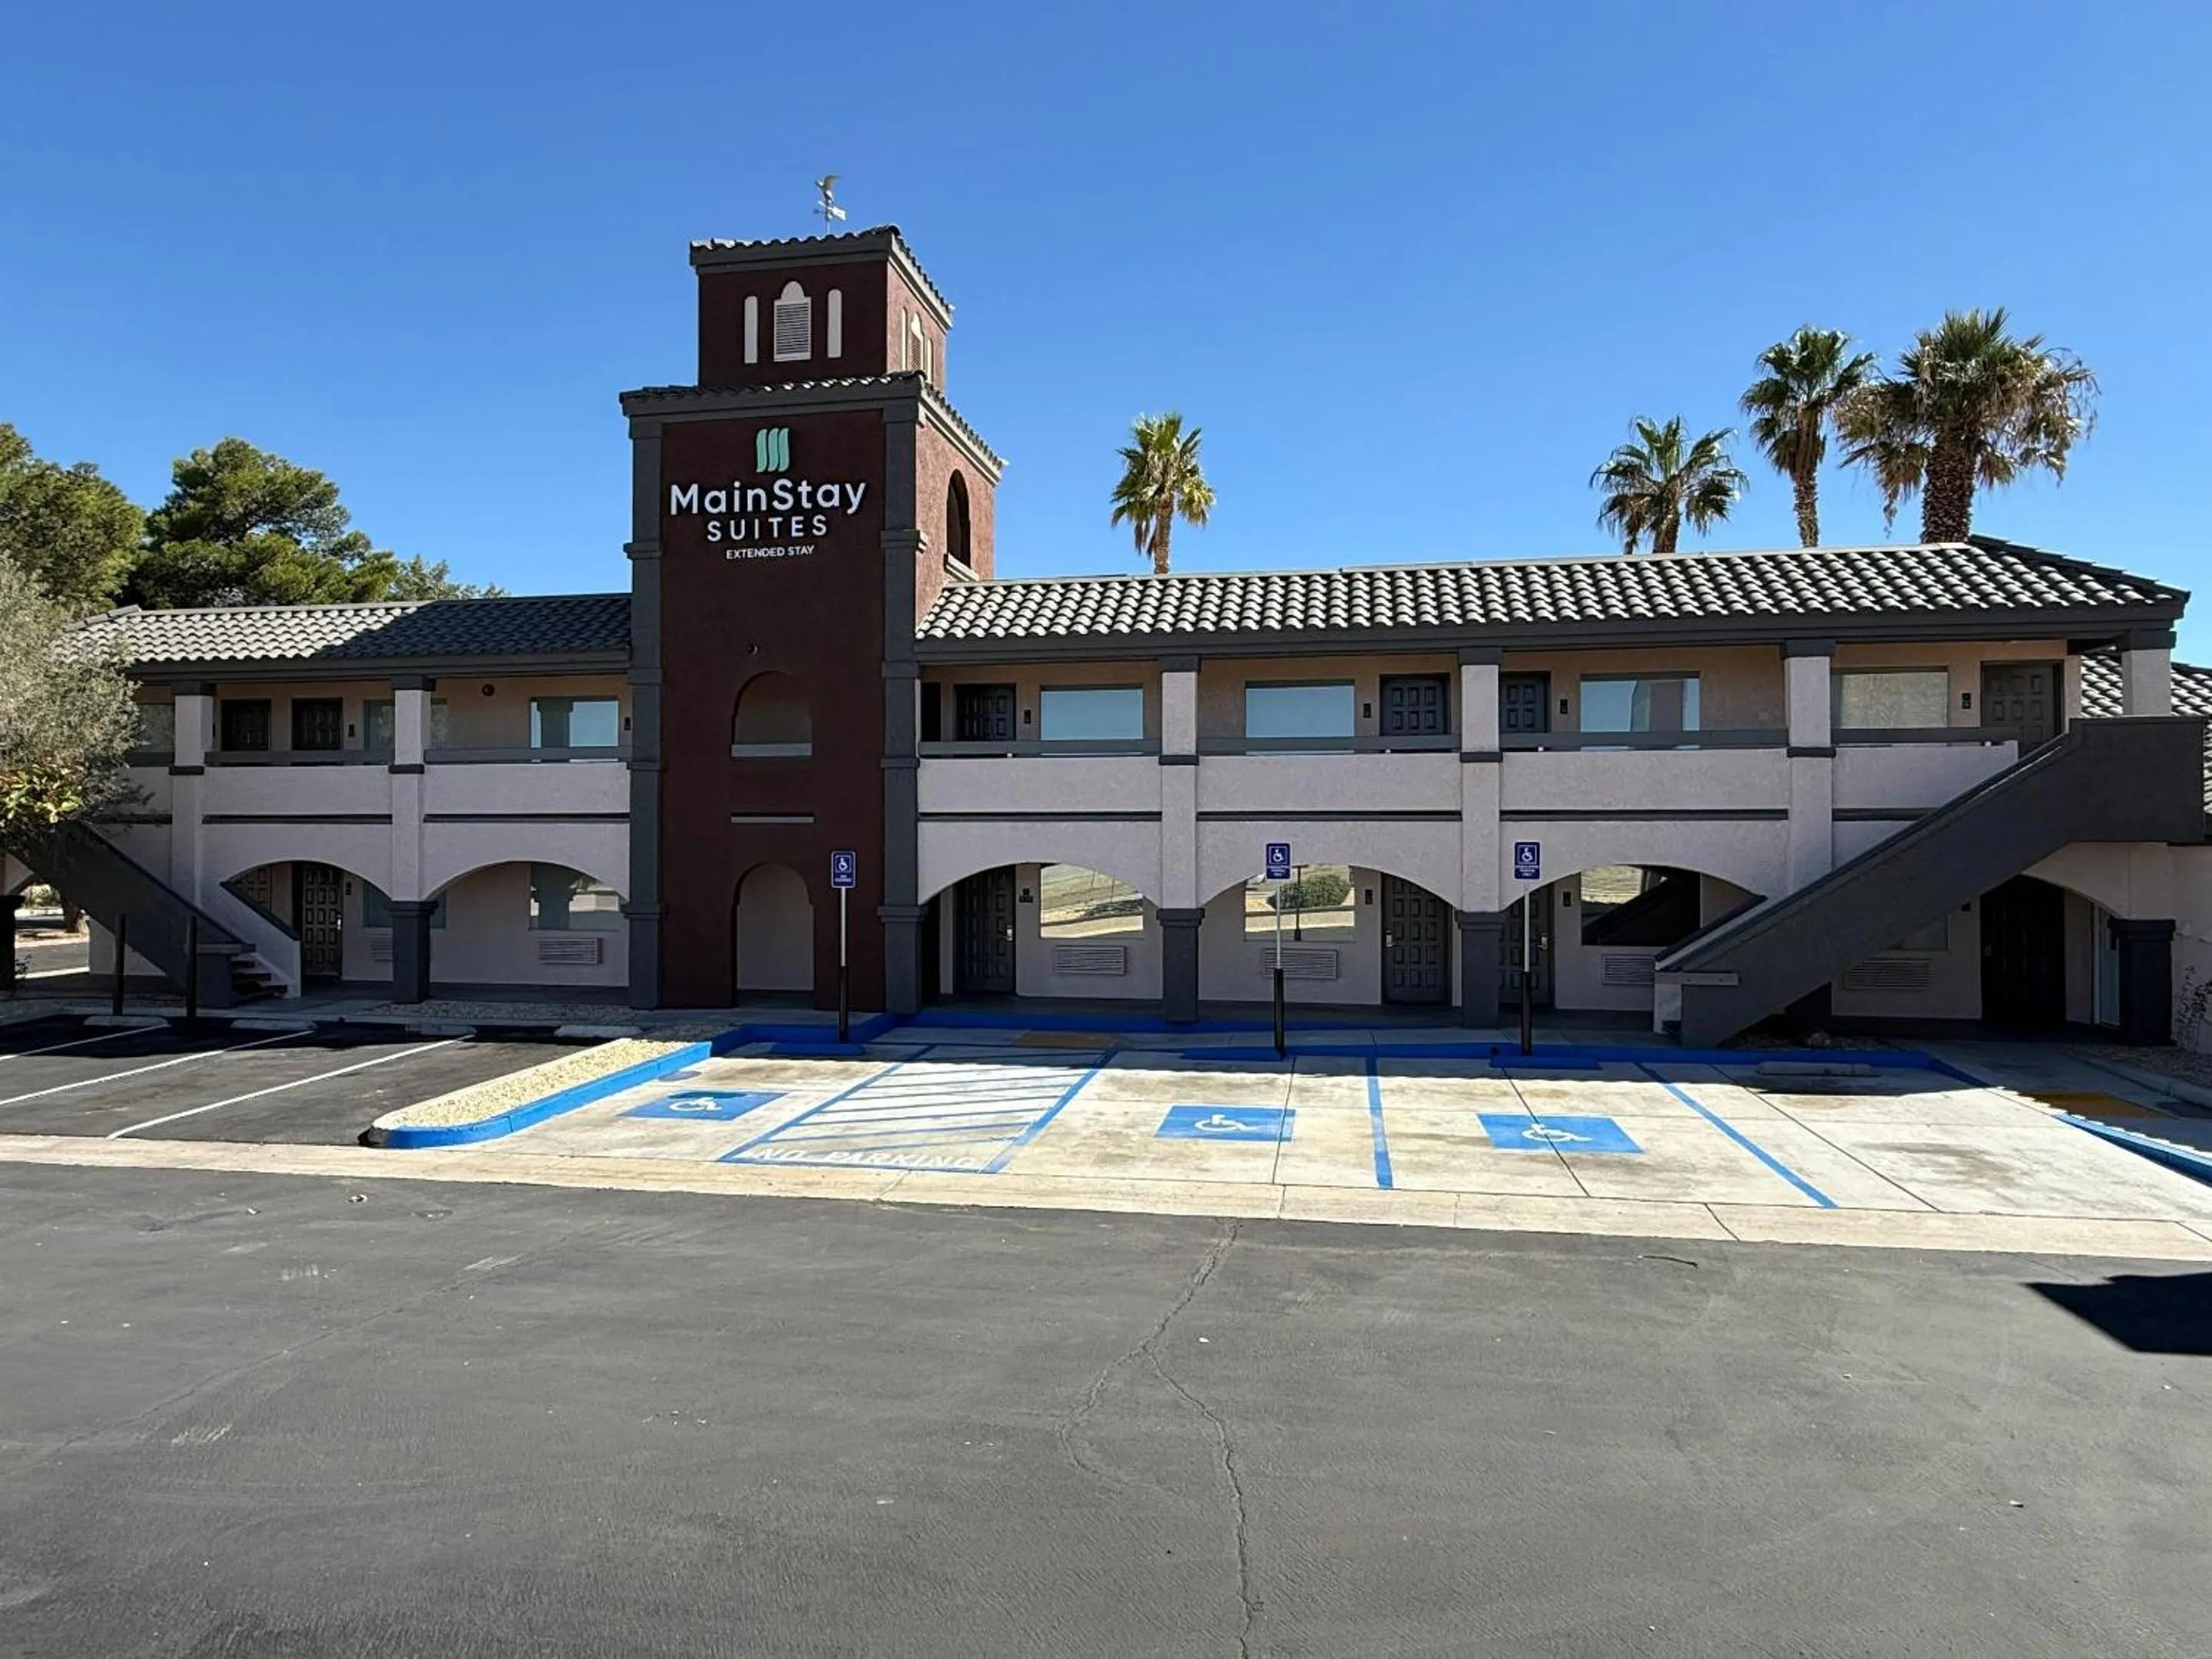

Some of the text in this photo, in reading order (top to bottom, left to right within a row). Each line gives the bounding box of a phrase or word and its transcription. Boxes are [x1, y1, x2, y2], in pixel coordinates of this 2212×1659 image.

[671, 478, 866, 515] MainStay
[707, 515, 827, 541] SUITES
[726, 545, 815, 560] EXTENDED STAY
[755, 1148, 981, 1167] NO PARKING
